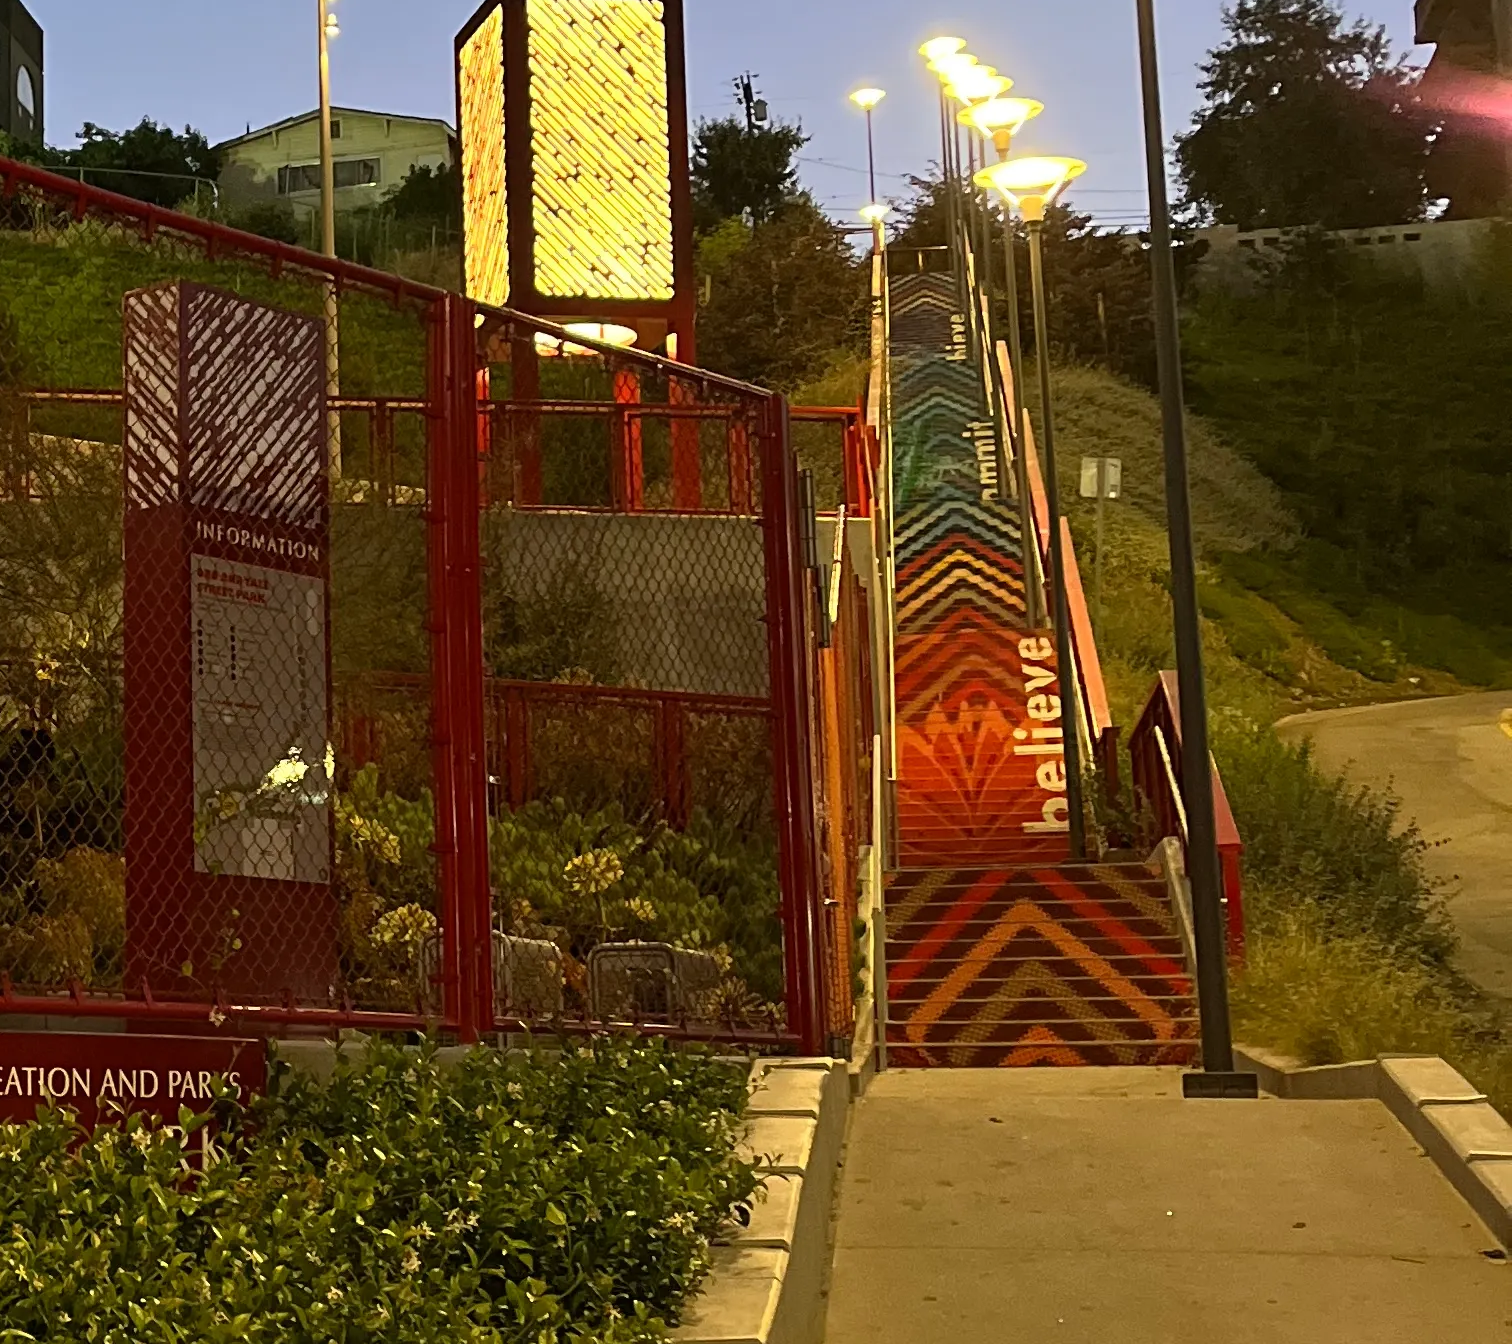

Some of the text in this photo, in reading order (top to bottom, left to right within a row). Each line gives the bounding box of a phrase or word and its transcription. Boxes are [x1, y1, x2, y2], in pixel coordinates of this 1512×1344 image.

[196, 521, 319, 561] INFORMATION
[1012, 636, 1071, 833] believe
[100, 1068, 159, 1098] AND
[168, 1070, 242, 1099] PARS
